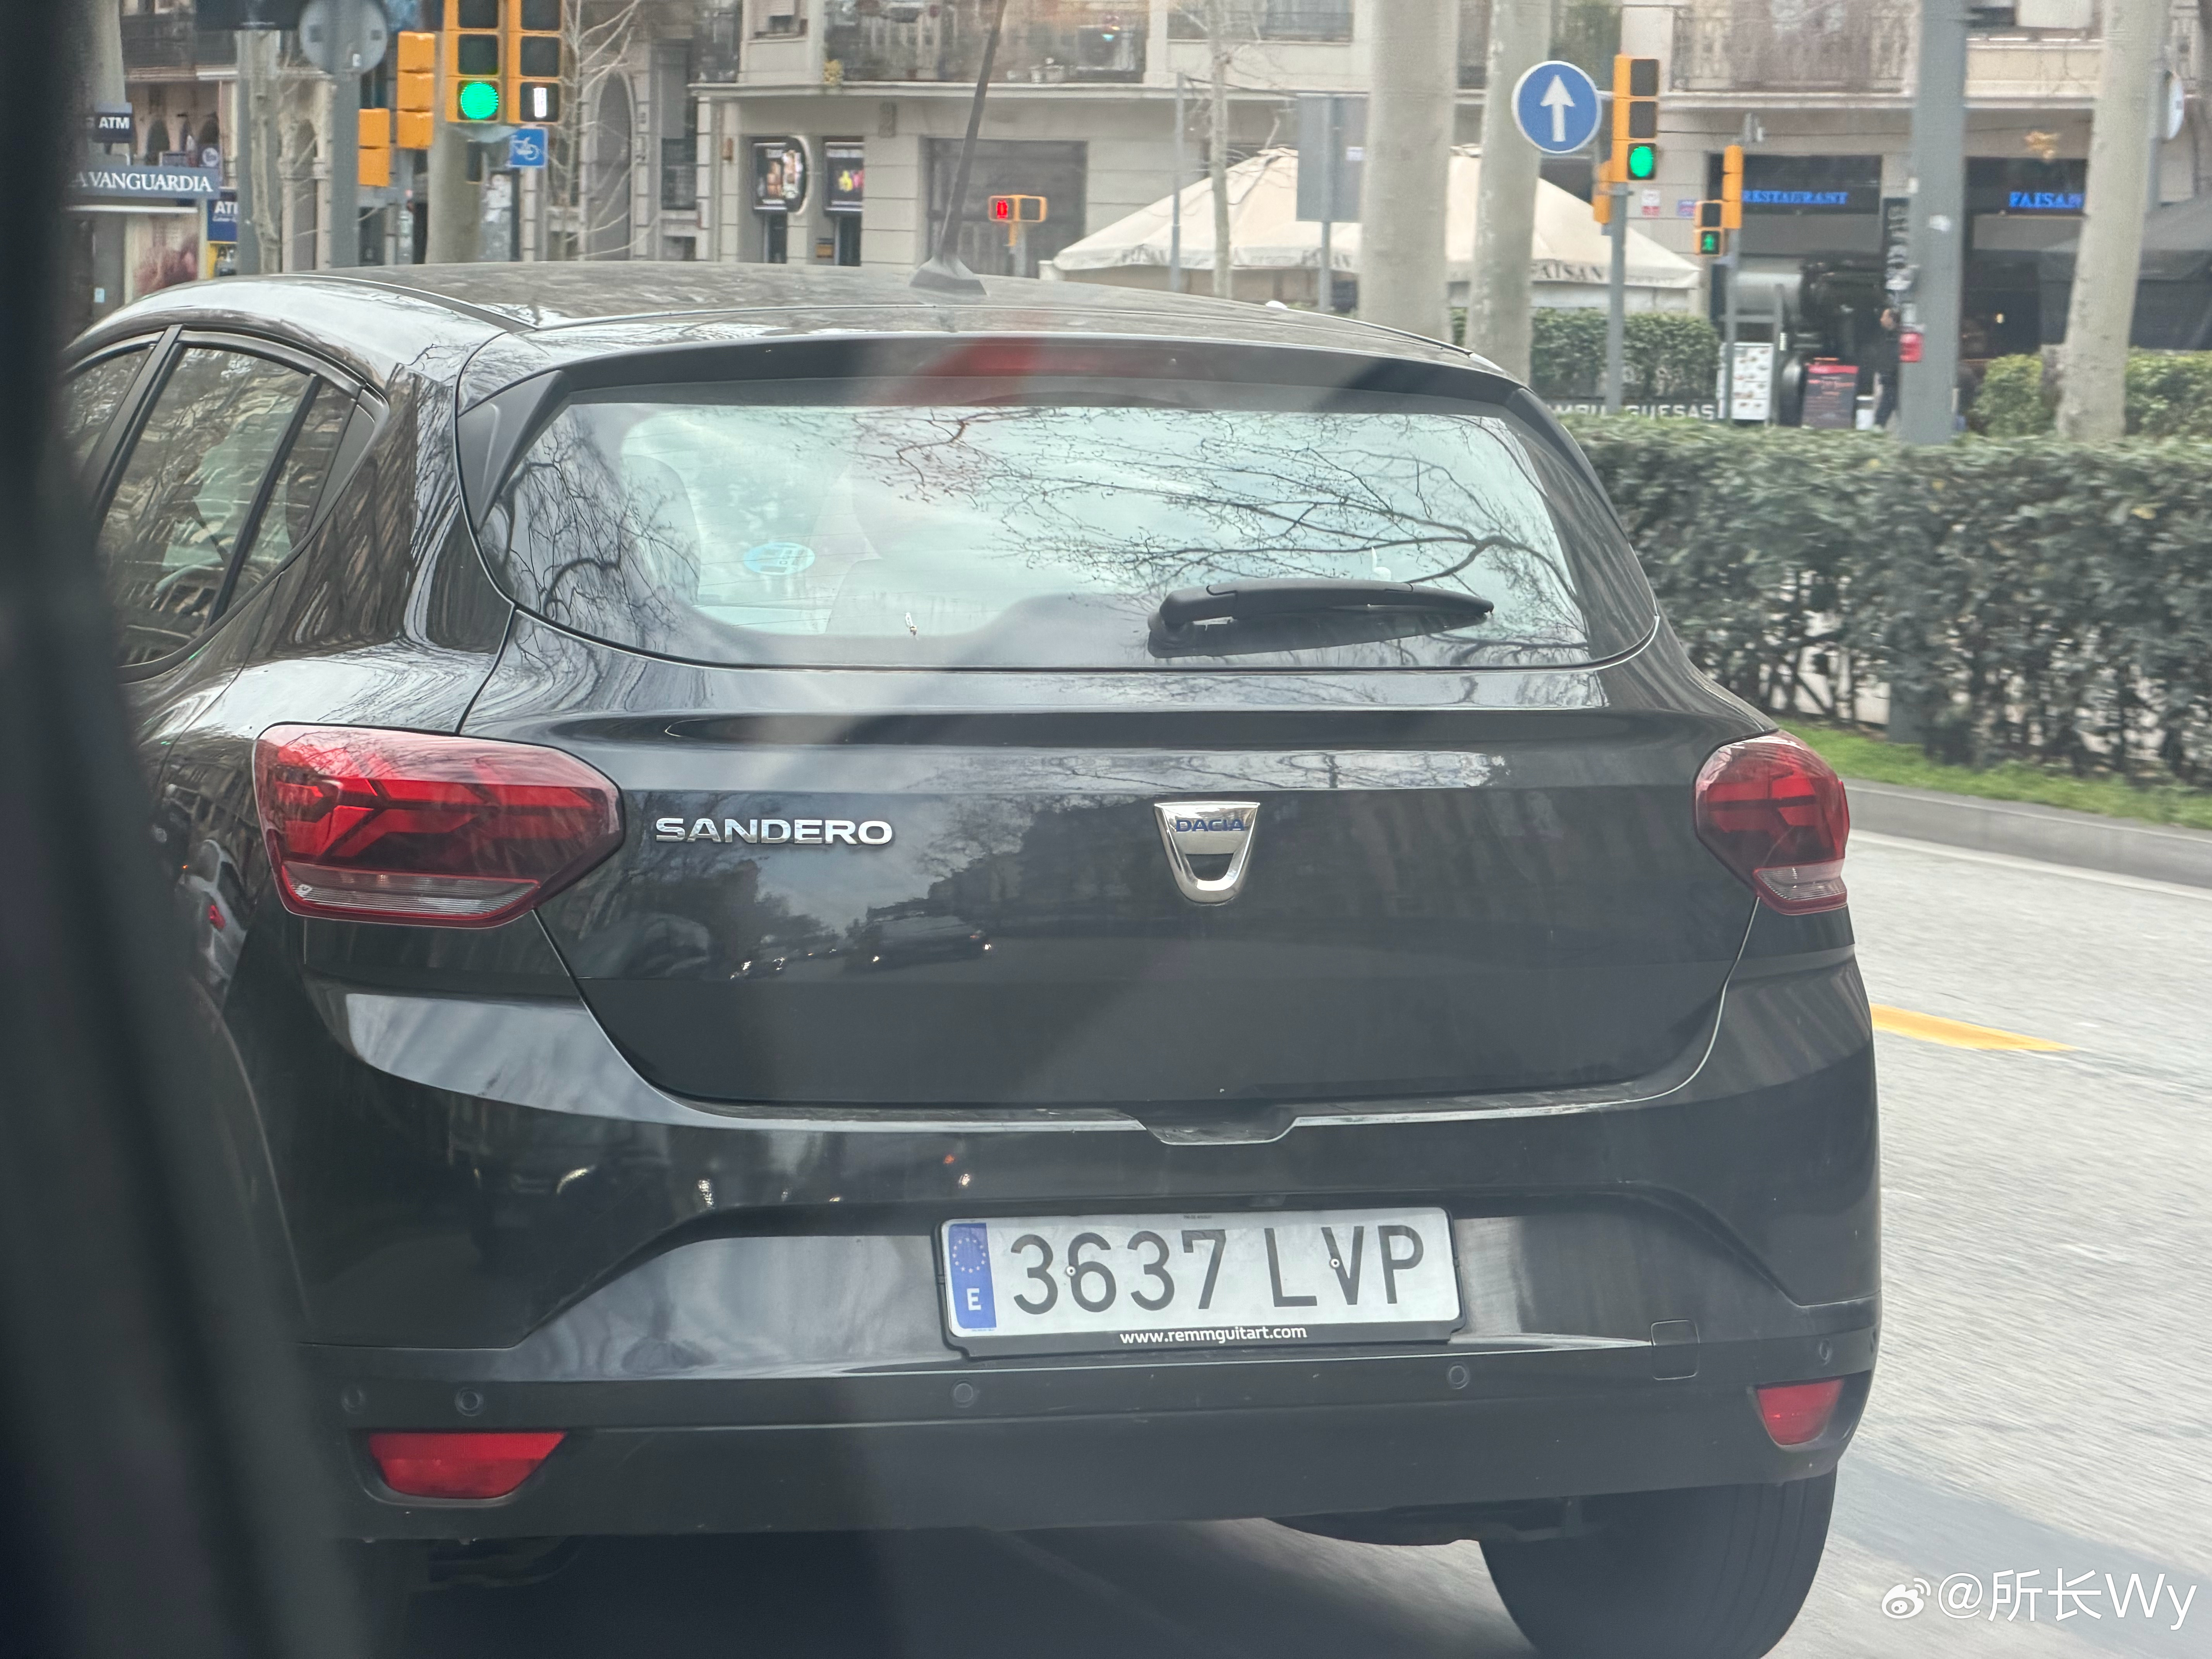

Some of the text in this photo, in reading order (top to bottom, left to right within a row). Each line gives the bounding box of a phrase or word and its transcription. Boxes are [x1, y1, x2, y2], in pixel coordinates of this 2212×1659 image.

[99, 117, 130, 129] ATM
[88, 172, 213, 192] VANGUARDIA
[656, 817, 892, 845] SANDERO
[1175, 819, 1245, 832] DACIA
[1010, 1224, 1424, 1315] 3637 LVP
[966, 1288, 982, 1311] E
[1120, 1326, 1307, 1344] www.remmguitart.com
